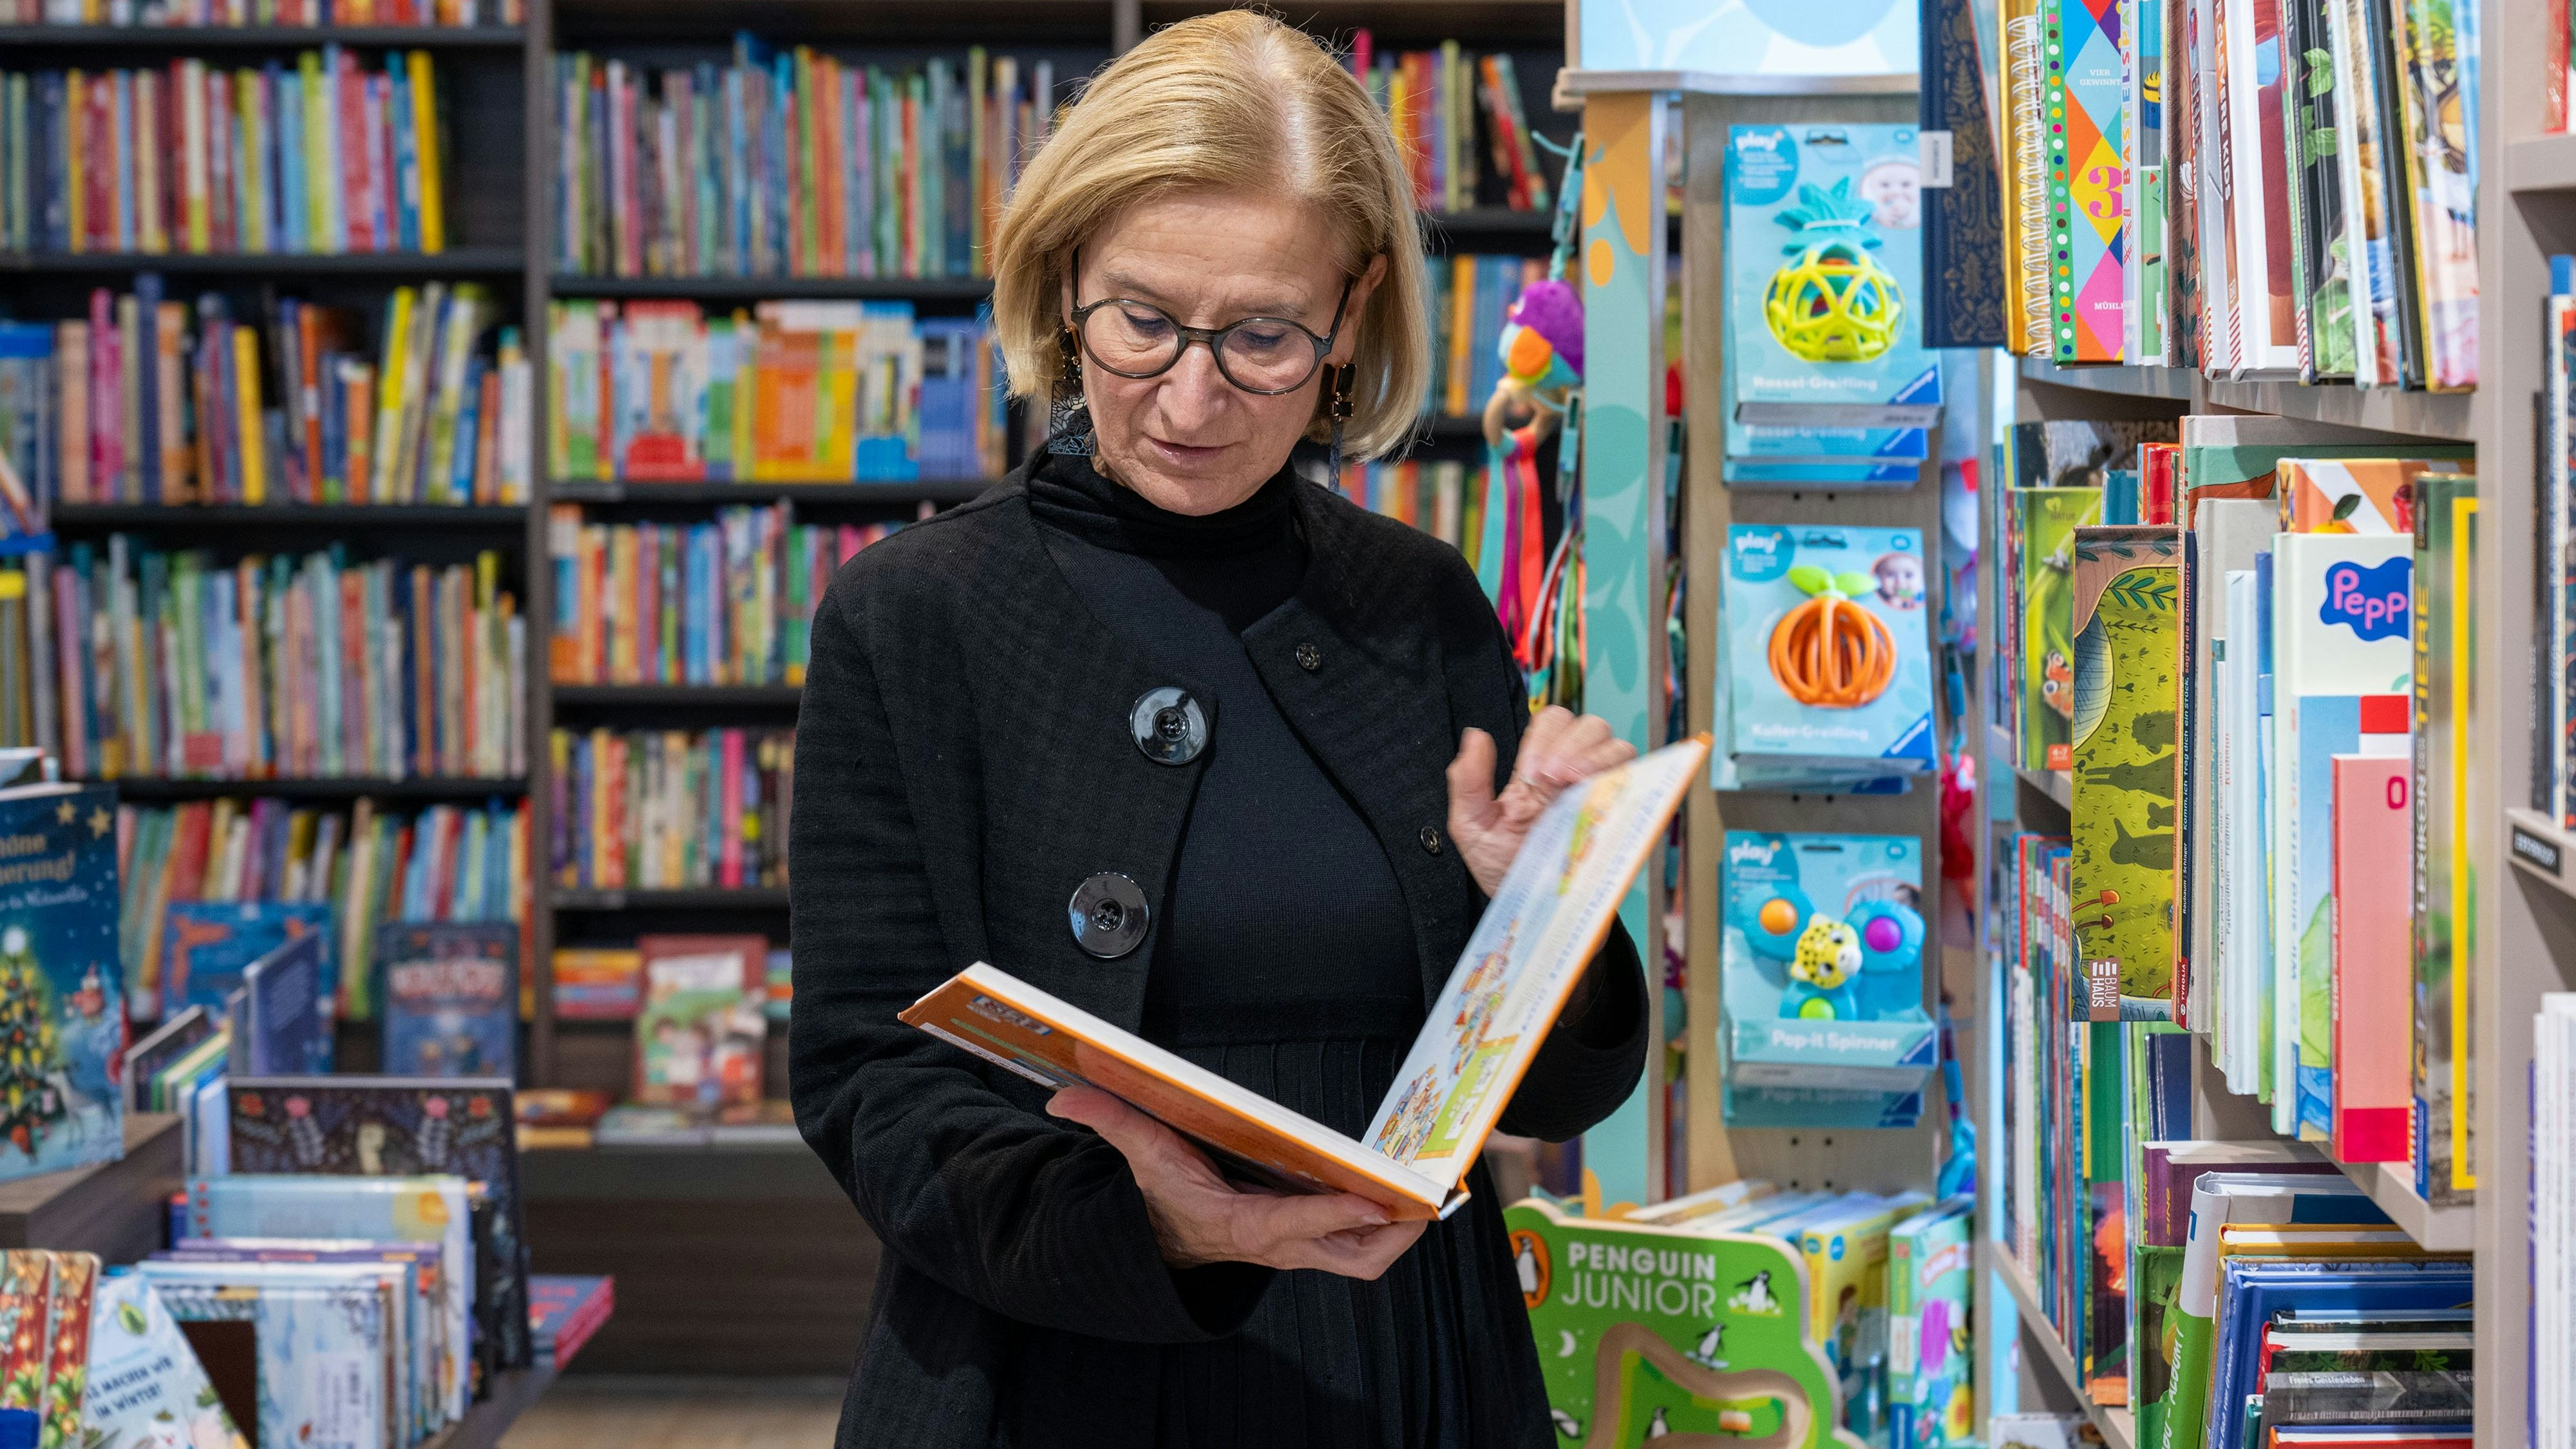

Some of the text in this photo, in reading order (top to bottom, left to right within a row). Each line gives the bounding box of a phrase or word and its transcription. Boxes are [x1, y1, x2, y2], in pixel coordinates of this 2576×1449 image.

[2121, 0, 2133, 186] BASTELSPA
[2217, 23, 2228, 135] CLEVERE
[2222, 138, 2231, 201] KIDS
[2088, 166, 2123, 220] 3
[1734, 531, 1777, 554] play
[2177, 561, 2183, 576] IN
[2333, 569, 2409, 630] Pepp
[2414, 584, 2429, 732] TIERE
[1730, 839, 1774, 866] play
[2415, 774, 2427, 913] LEXIKON
[2092, 978, 2105, 1008] HAUS
[2105, 978, 2117, 1008] BAUM
[1826, 1032, 1897, 1053] Spinner
[1568, 1242, 1716, 1282] PENGUIN
[1561, 1271, 1716, 1319] JUNIOR
[101, 1365, 149, 1392] MACHEN
[2168, 1338, 2183, 1405] ALBUM
[2288, 1375, 2365, 1385] Freies Geistesleben
[93, 1403, 113, 1420] IM
